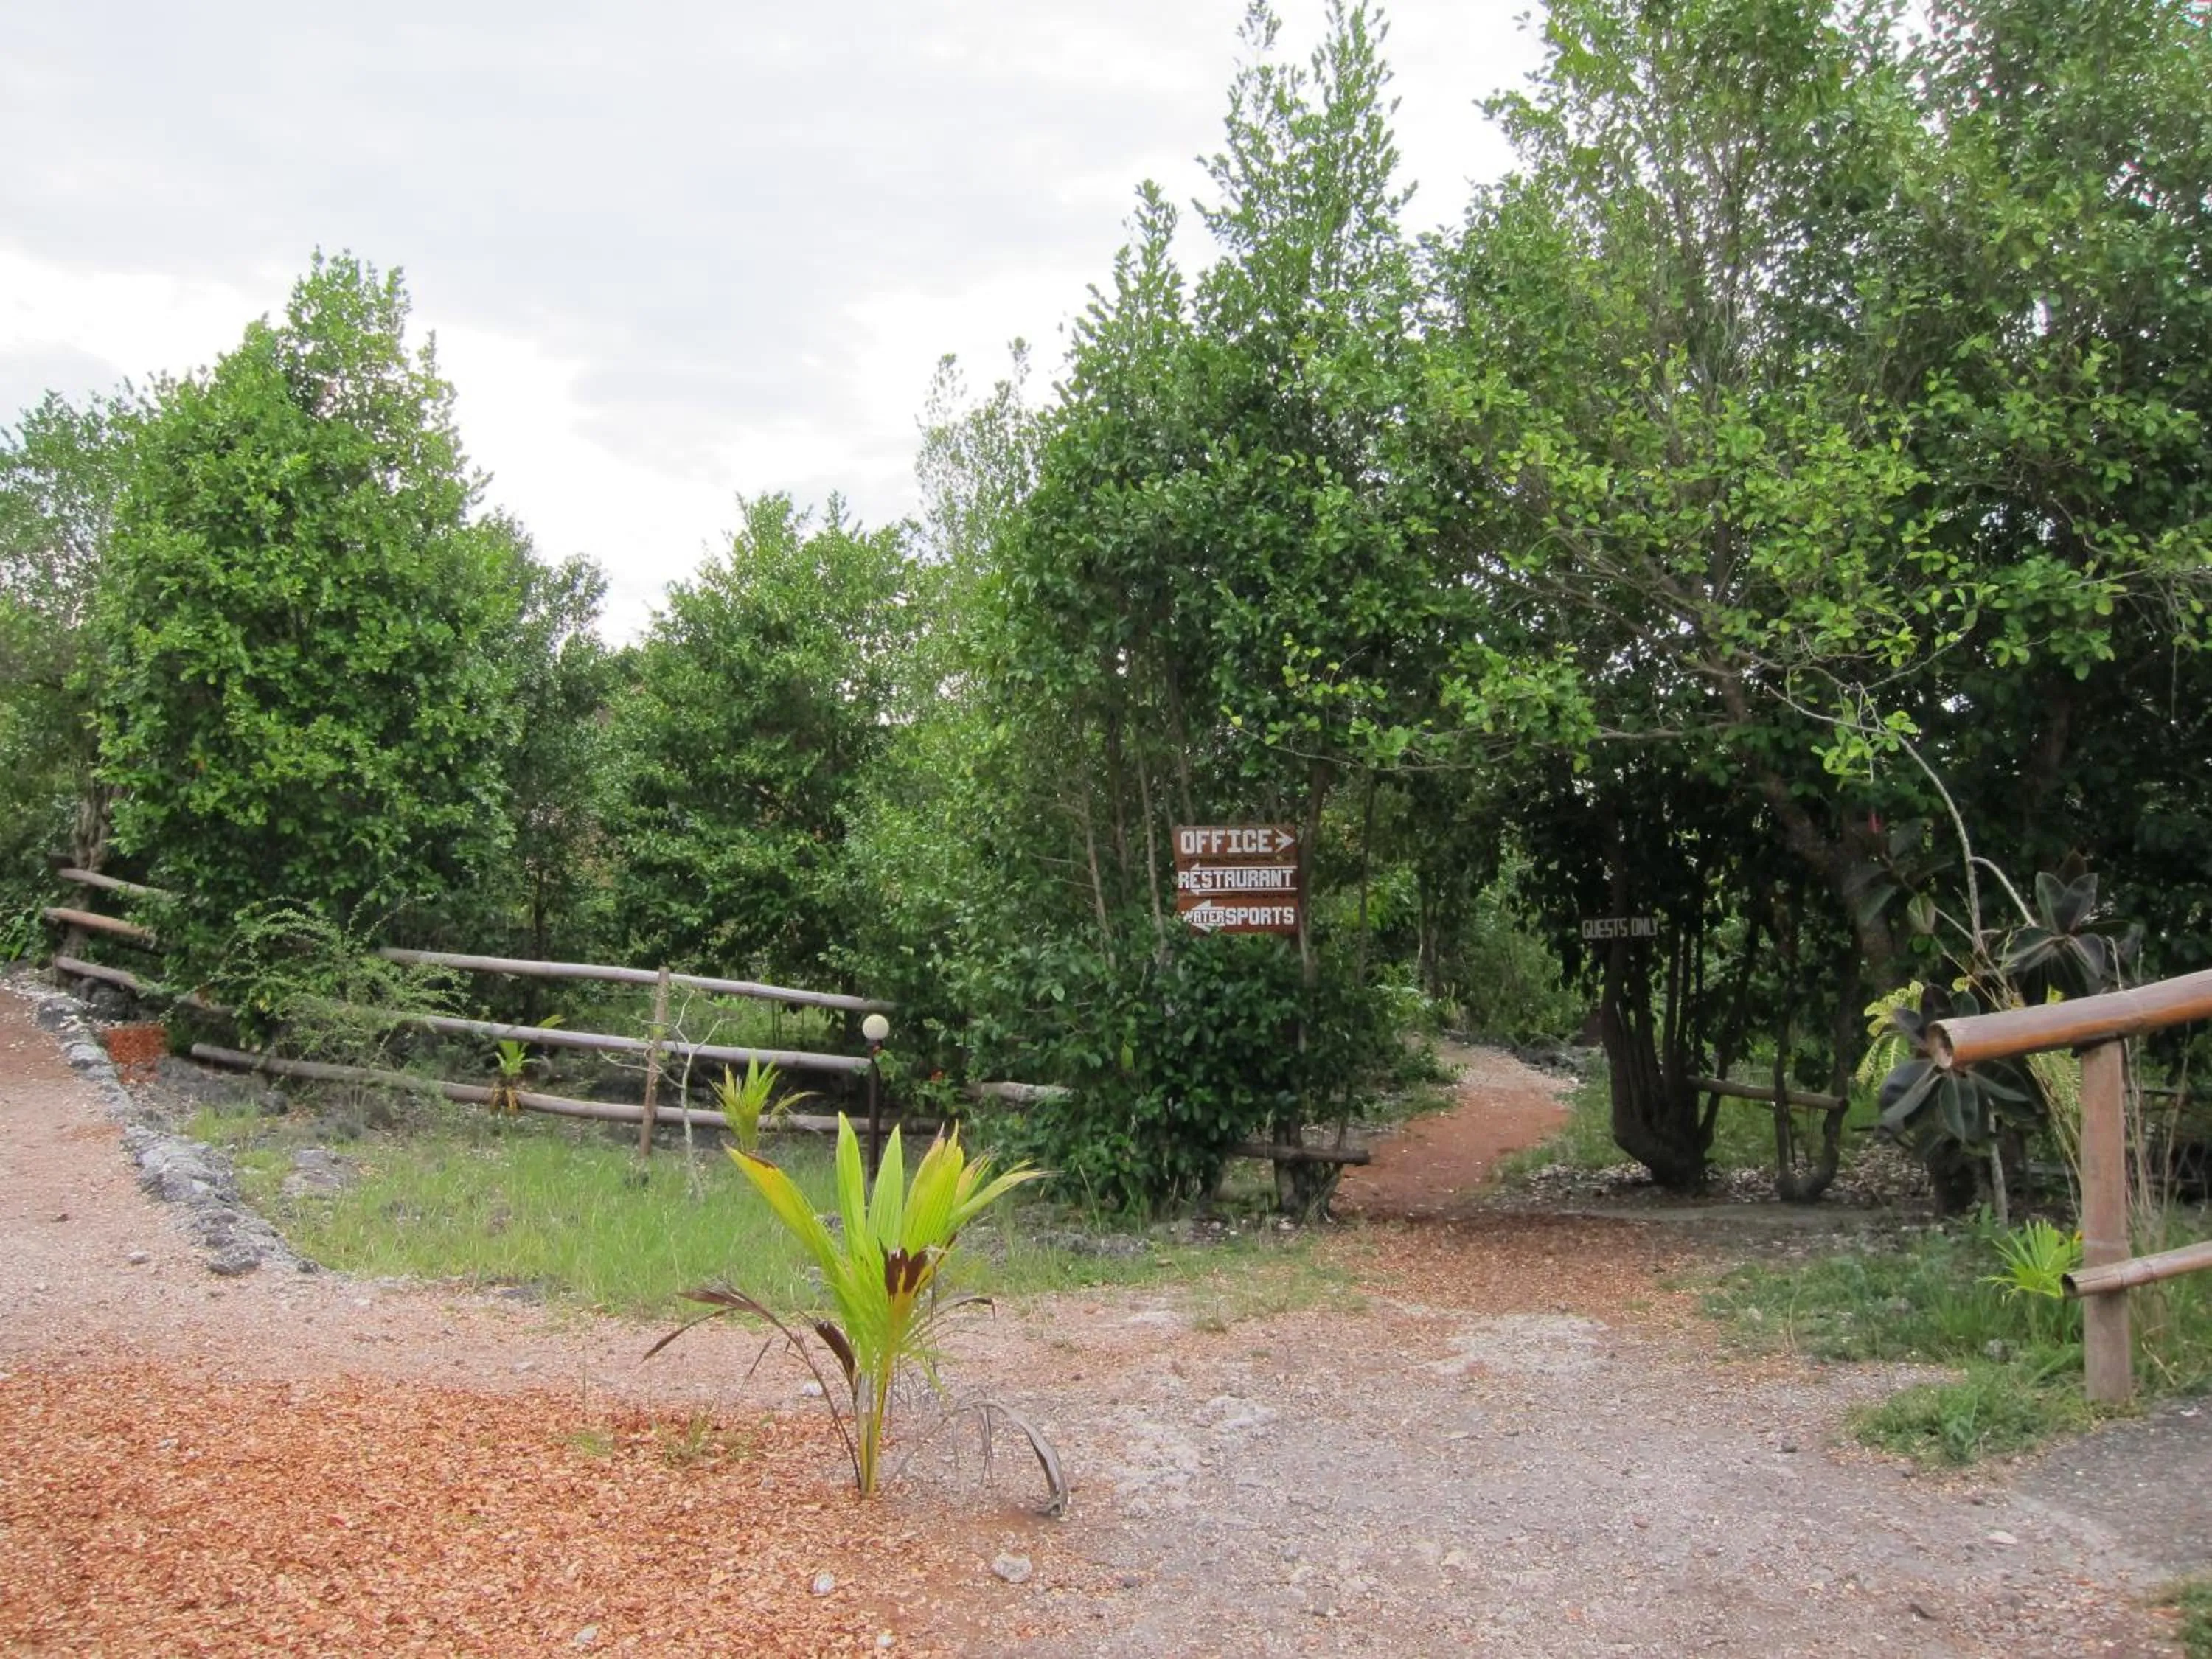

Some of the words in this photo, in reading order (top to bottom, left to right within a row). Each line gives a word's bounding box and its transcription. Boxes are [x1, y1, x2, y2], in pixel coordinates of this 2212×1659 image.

[1180, 830, 1273, 855] OFFICE
[1178, 869, 1293, 888] RESTAURANT
[1582, 918, 1628, 939] GUESTS
[1630, 917, 1658, 936] ONLY
